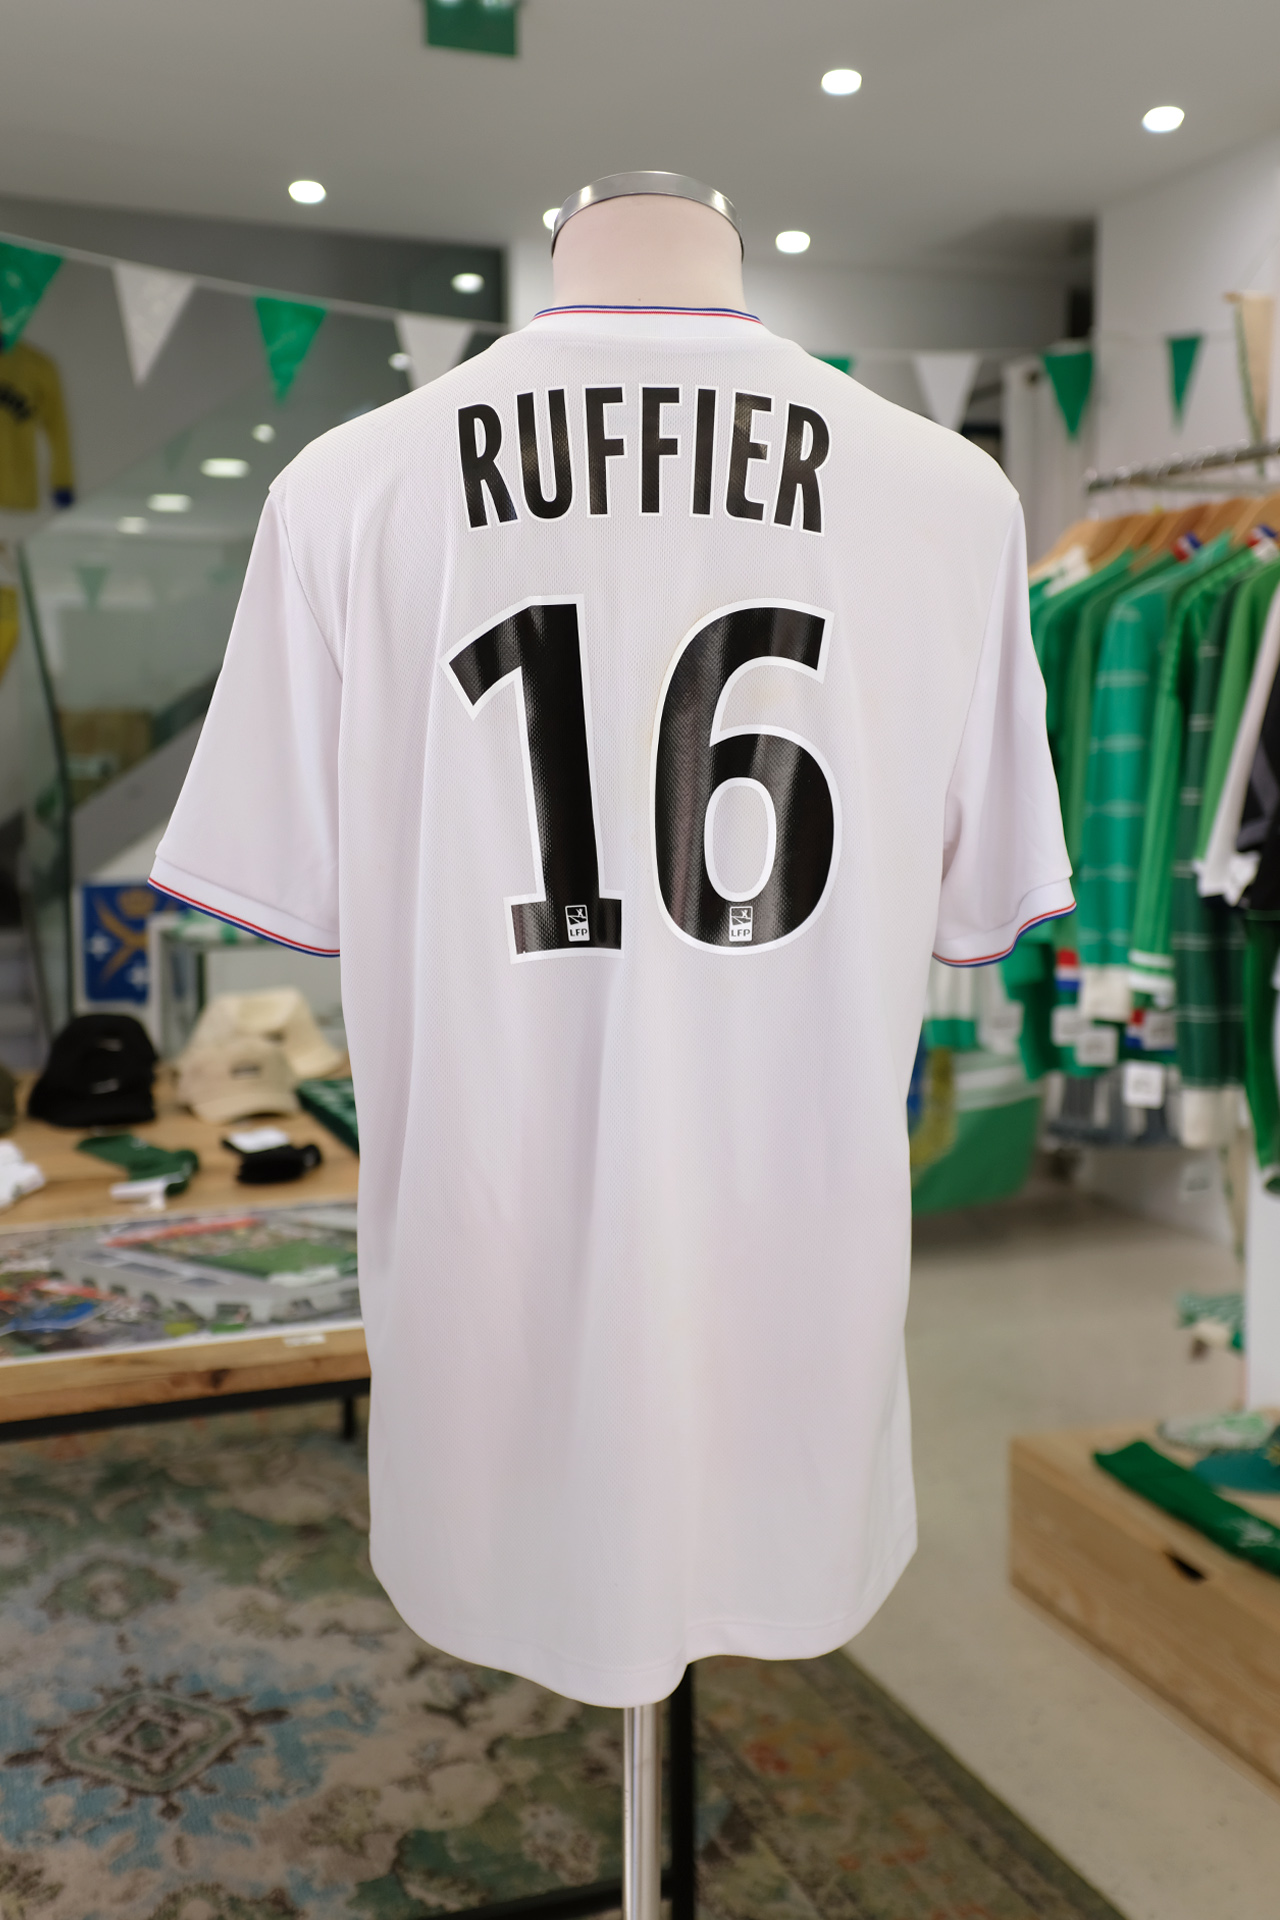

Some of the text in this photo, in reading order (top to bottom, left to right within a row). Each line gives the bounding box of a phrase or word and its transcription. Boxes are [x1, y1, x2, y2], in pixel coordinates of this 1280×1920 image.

[457, 385, 831, 534] RUFFIER
[446, 602, 836, 955] 16
[569, 928, 588, 938] LFP
[730, 928, 751, 938] LFP
